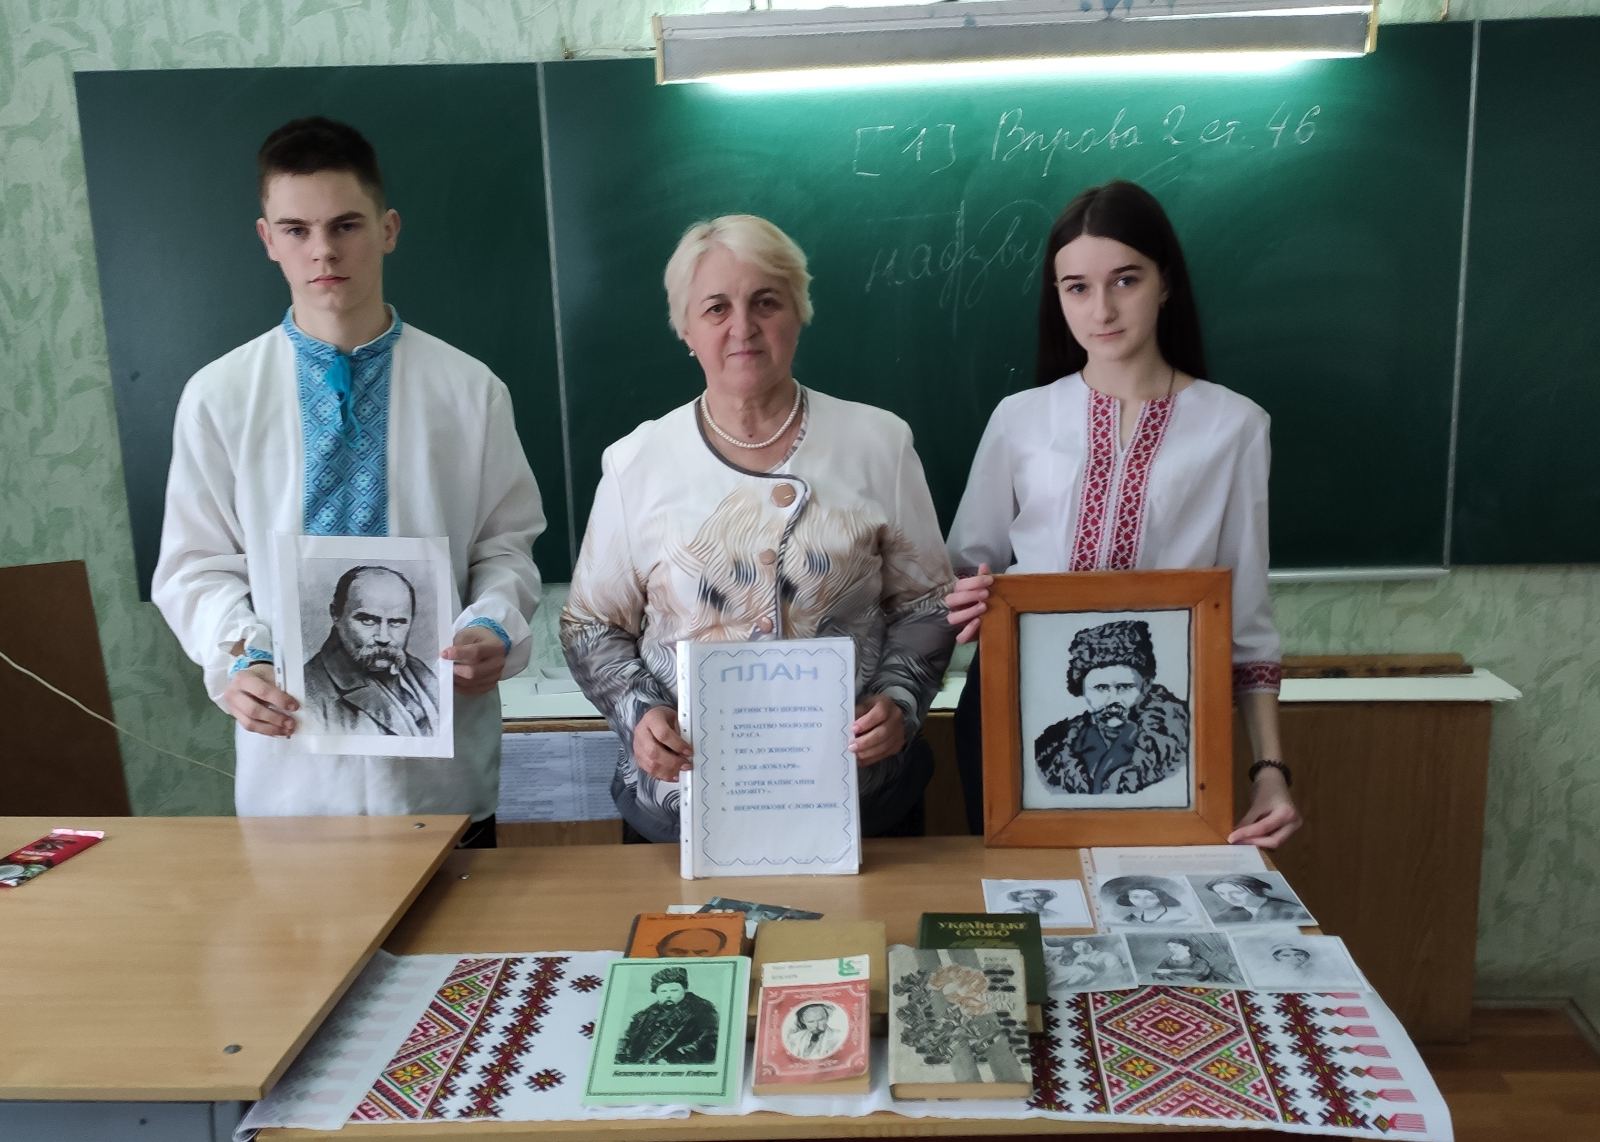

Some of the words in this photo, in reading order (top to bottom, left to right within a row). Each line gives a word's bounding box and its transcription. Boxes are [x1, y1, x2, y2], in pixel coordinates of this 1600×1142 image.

[991, 107, 1143, 178] Вправа
[1162, 104, 1187, 146] 2
[1266, 100, 1322, 149] 46
[721, 662, 819, 682] ПЛАН
[938, 921, 1025, 930] УКРАЇНСЬКЕ
[955, 929, 1011, 937] СЛОВО
